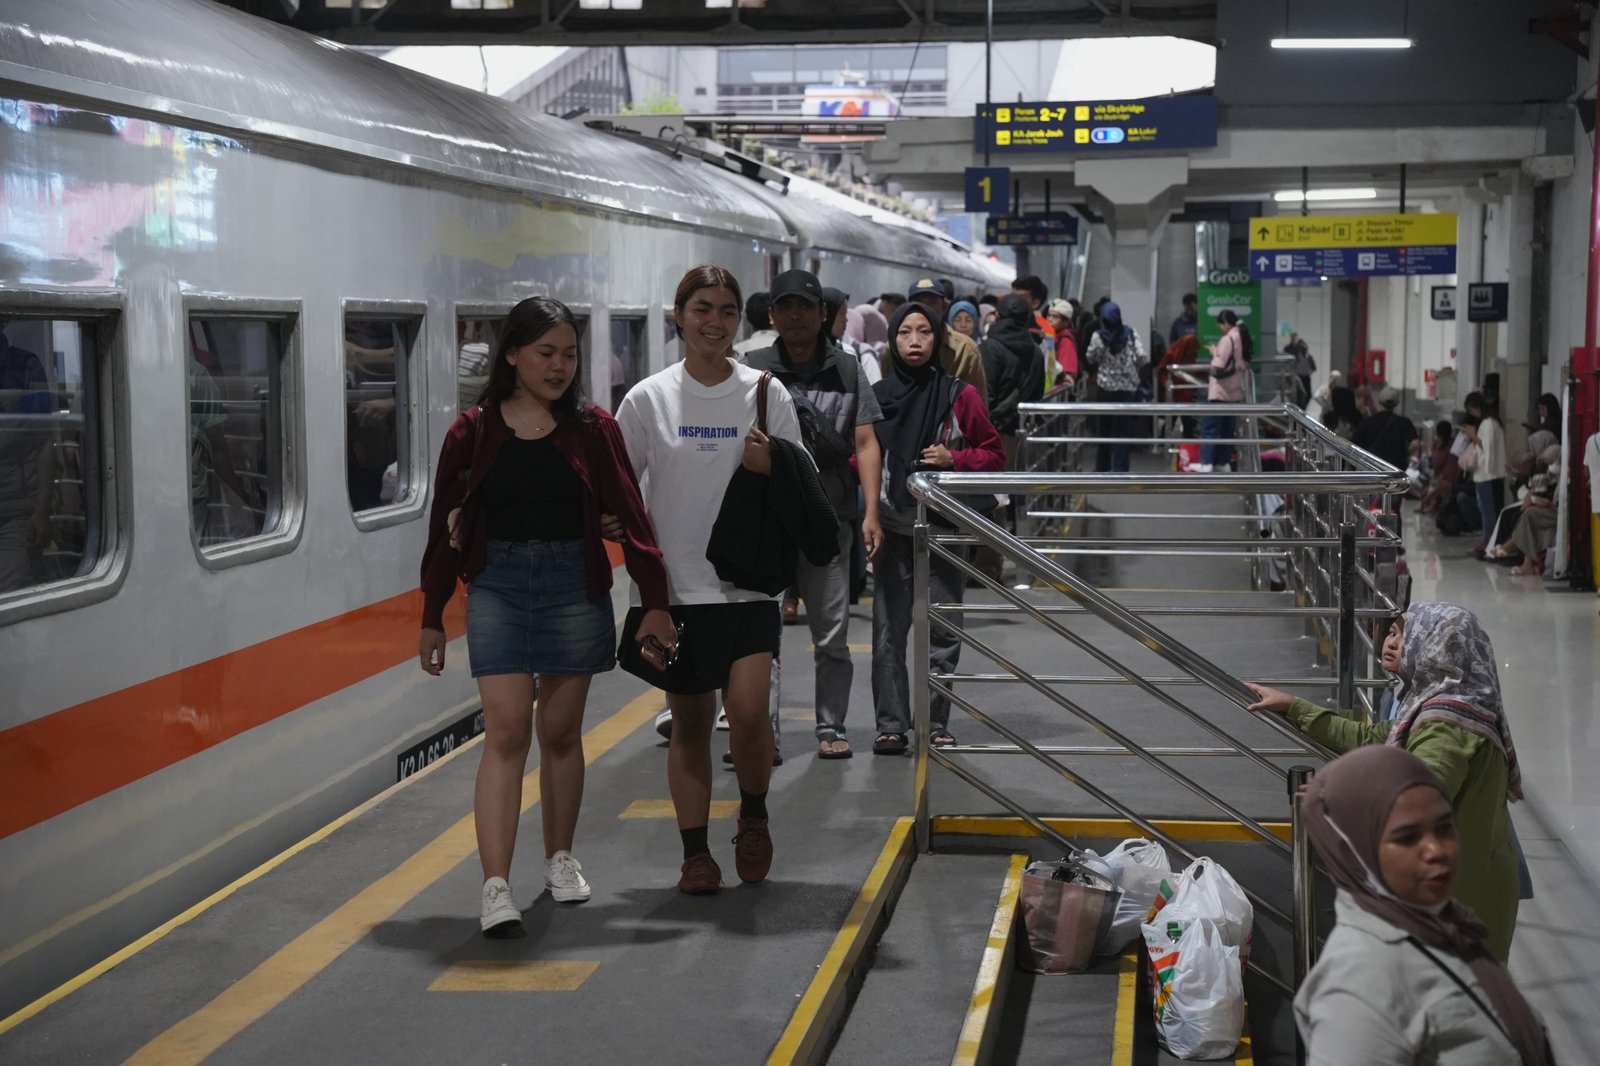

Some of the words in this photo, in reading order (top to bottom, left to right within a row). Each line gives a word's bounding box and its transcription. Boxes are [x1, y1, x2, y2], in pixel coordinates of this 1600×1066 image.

[977, 176, 992, 203] 1
[1299, 224, 1331, 234] Keluar
[1209, 270, 1250, 284] Grab
[1206, 294, 1252, 305] GrabCar
[678, 426, 738, 439] INSPIRATION
